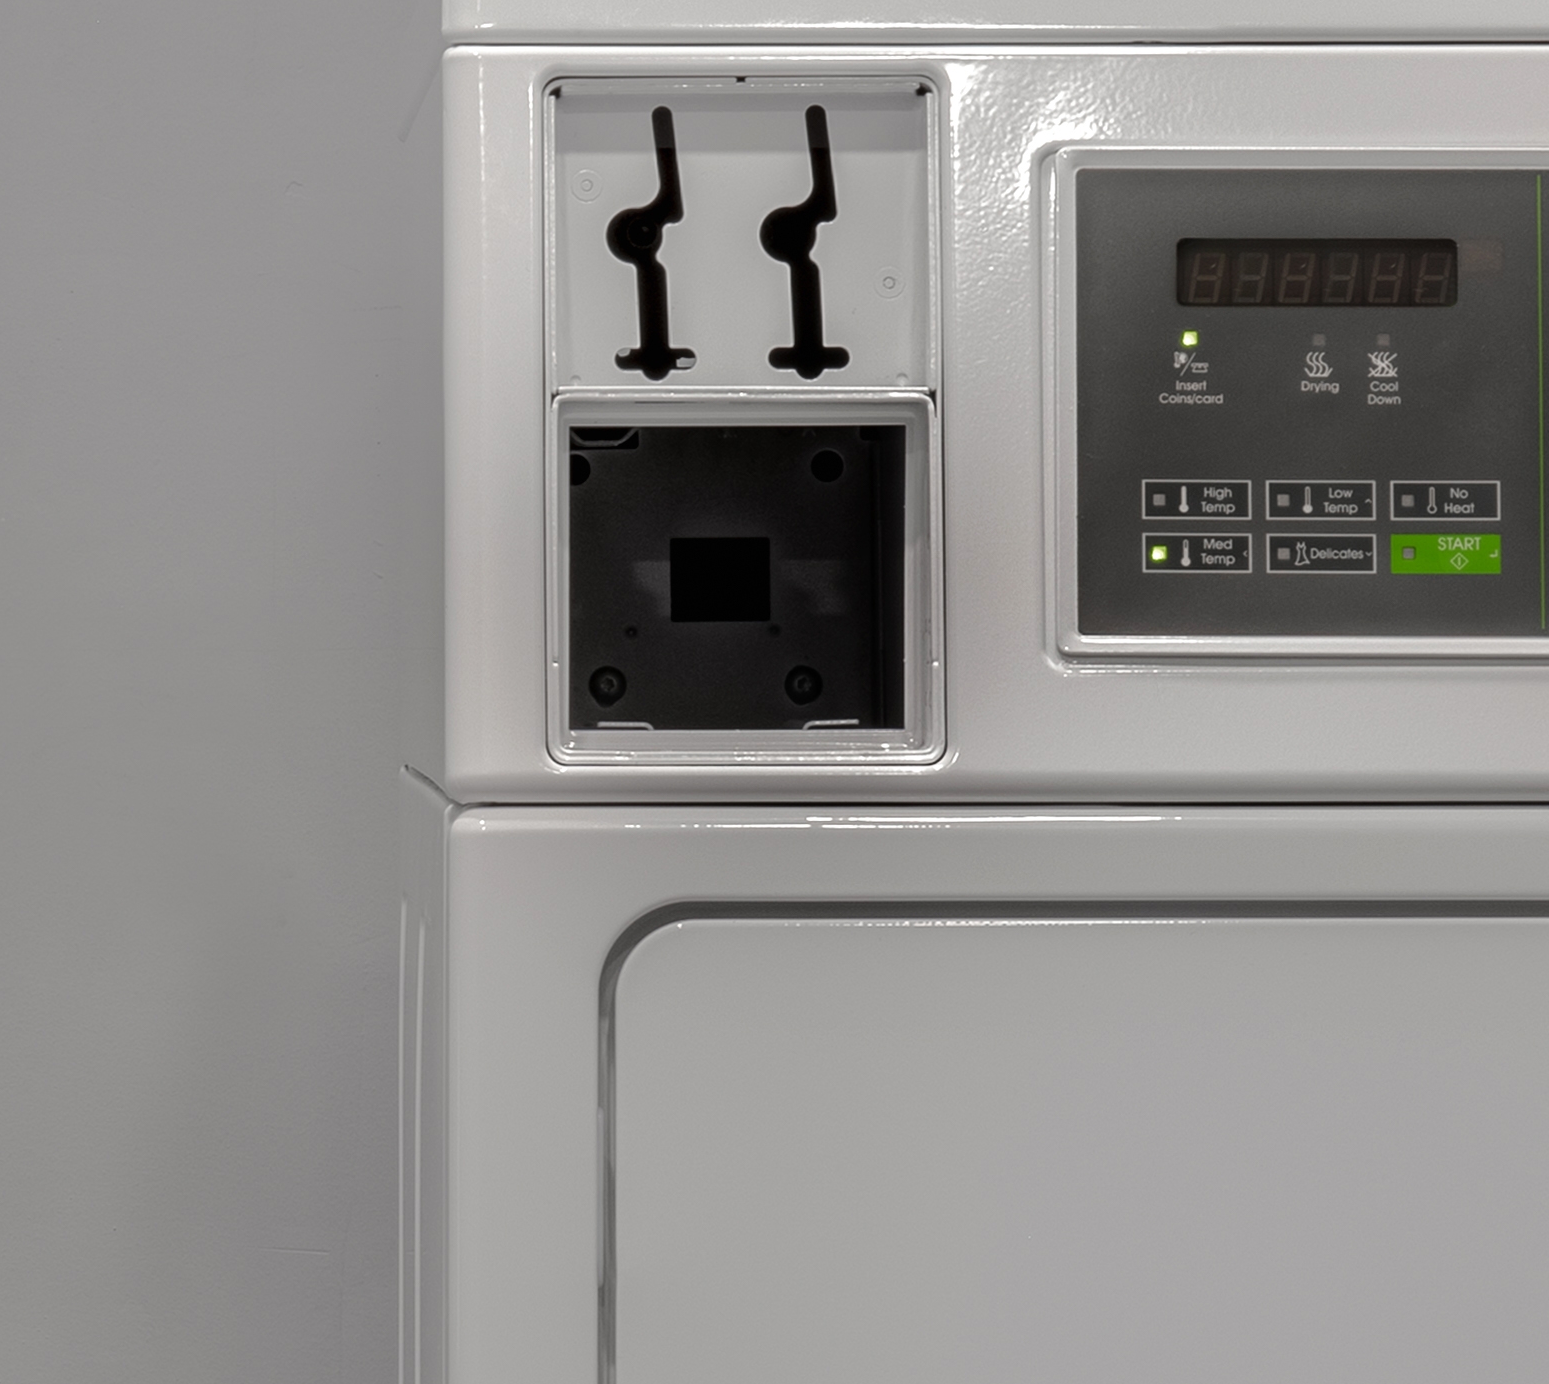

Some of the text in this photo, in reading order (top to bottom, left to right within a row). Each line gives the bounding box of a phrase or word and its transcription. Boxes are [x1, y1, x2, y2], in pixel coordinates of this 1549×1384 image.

[1175, 380, 1207, 391] Insert
[1300, 380, 1340, 394] Drying
[1369, 380, 1399, 392] Cool
[1158, 392, 1224, 405] Coins/card
[1367, 394, 1403, 405] Down
[1203, 487, 1233, 502] High
[1328, 487, 1354, 499] Low
[1449, 487, 1469, 500] No
[1200, 501, 1236, 516] Temp
[1323, 501, 1359, 516] Temp
[1444, 502, 1475, 514] Heat
[1203, 538, 1233, 550] Med
[1437, 537, 1482, 551] START
[1200, 553, 1236, 567] Temp
[1310, 547, 1364, 560] Delicates
